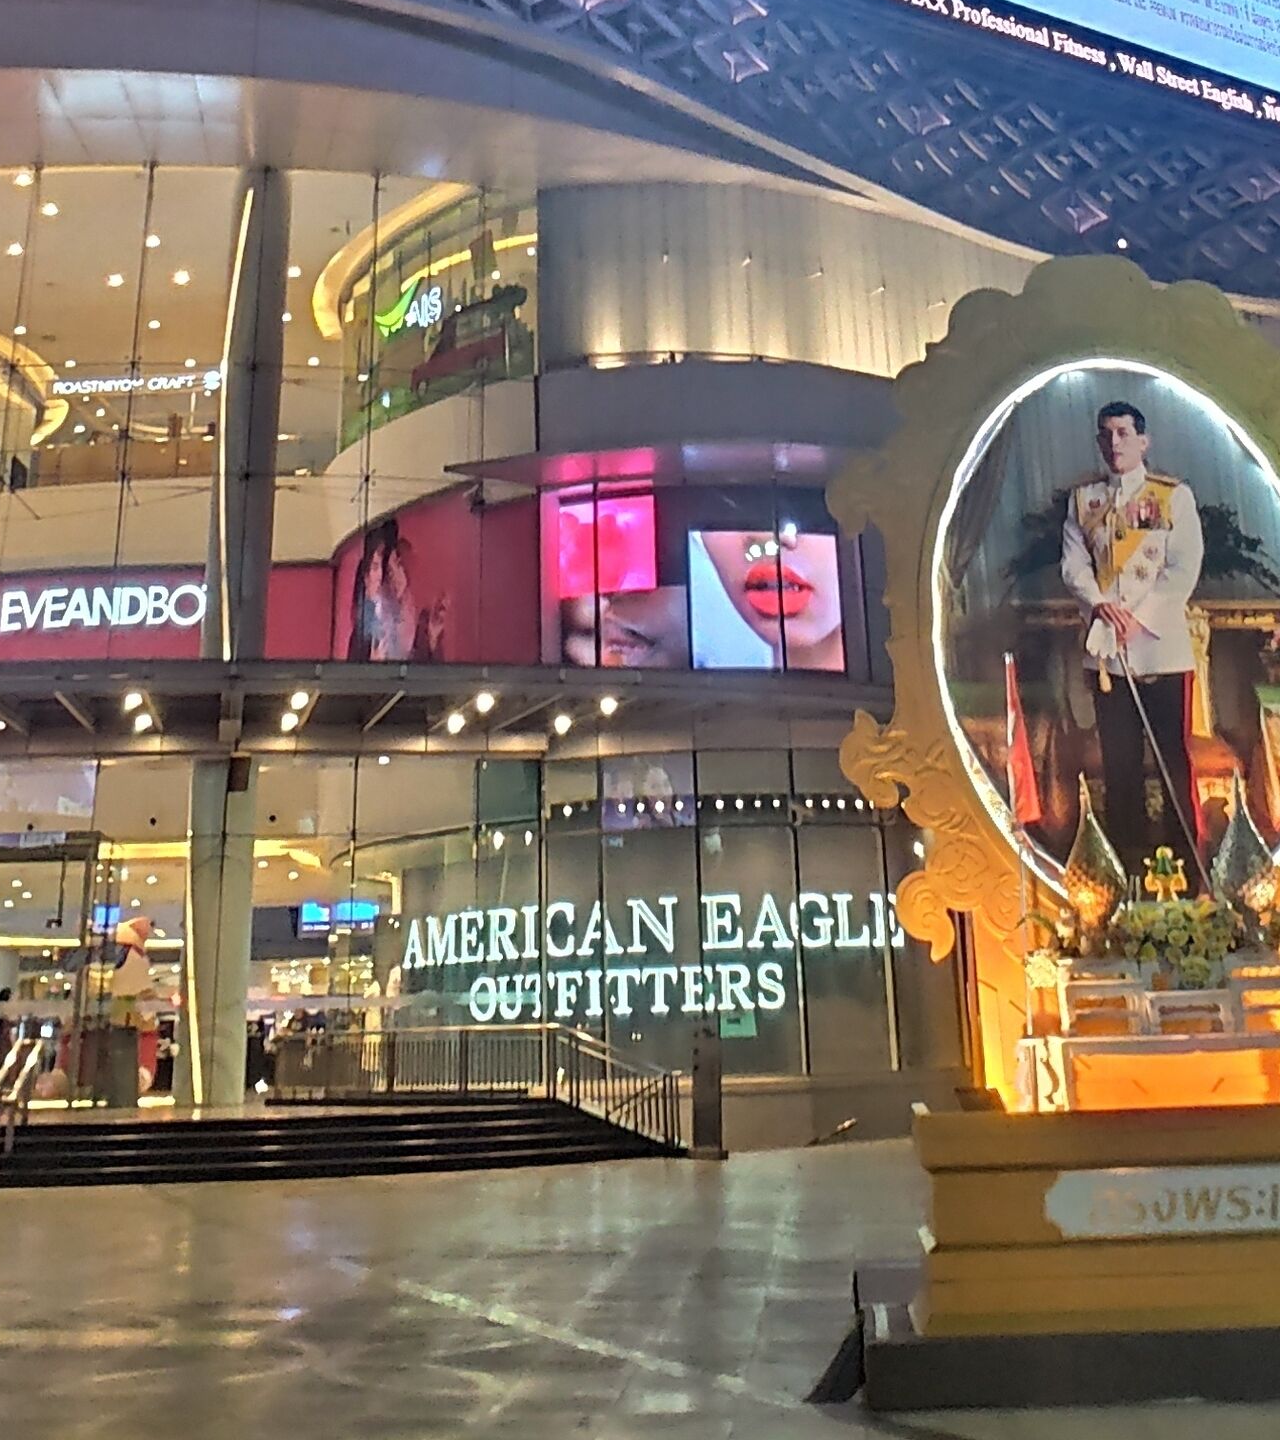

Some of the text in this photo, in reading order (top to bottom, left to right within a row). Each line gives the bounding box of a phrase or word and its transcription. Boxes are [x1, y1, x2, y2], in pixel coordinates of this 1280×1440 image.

[1052, 30, 1108, 67] Fitness
[1116, 51, 1155, 82] Wall
[1156, 66, 1200, 97] Street
[1201, 80, 1254, 115] English
[405, 287, 442, 328] AIS
[0, 583, 208, 633] EVEANDBO
[401, 891, 906, 970] AMERICAN EAGLE
[468, 961, 787, 1024] OUTFITTERS
